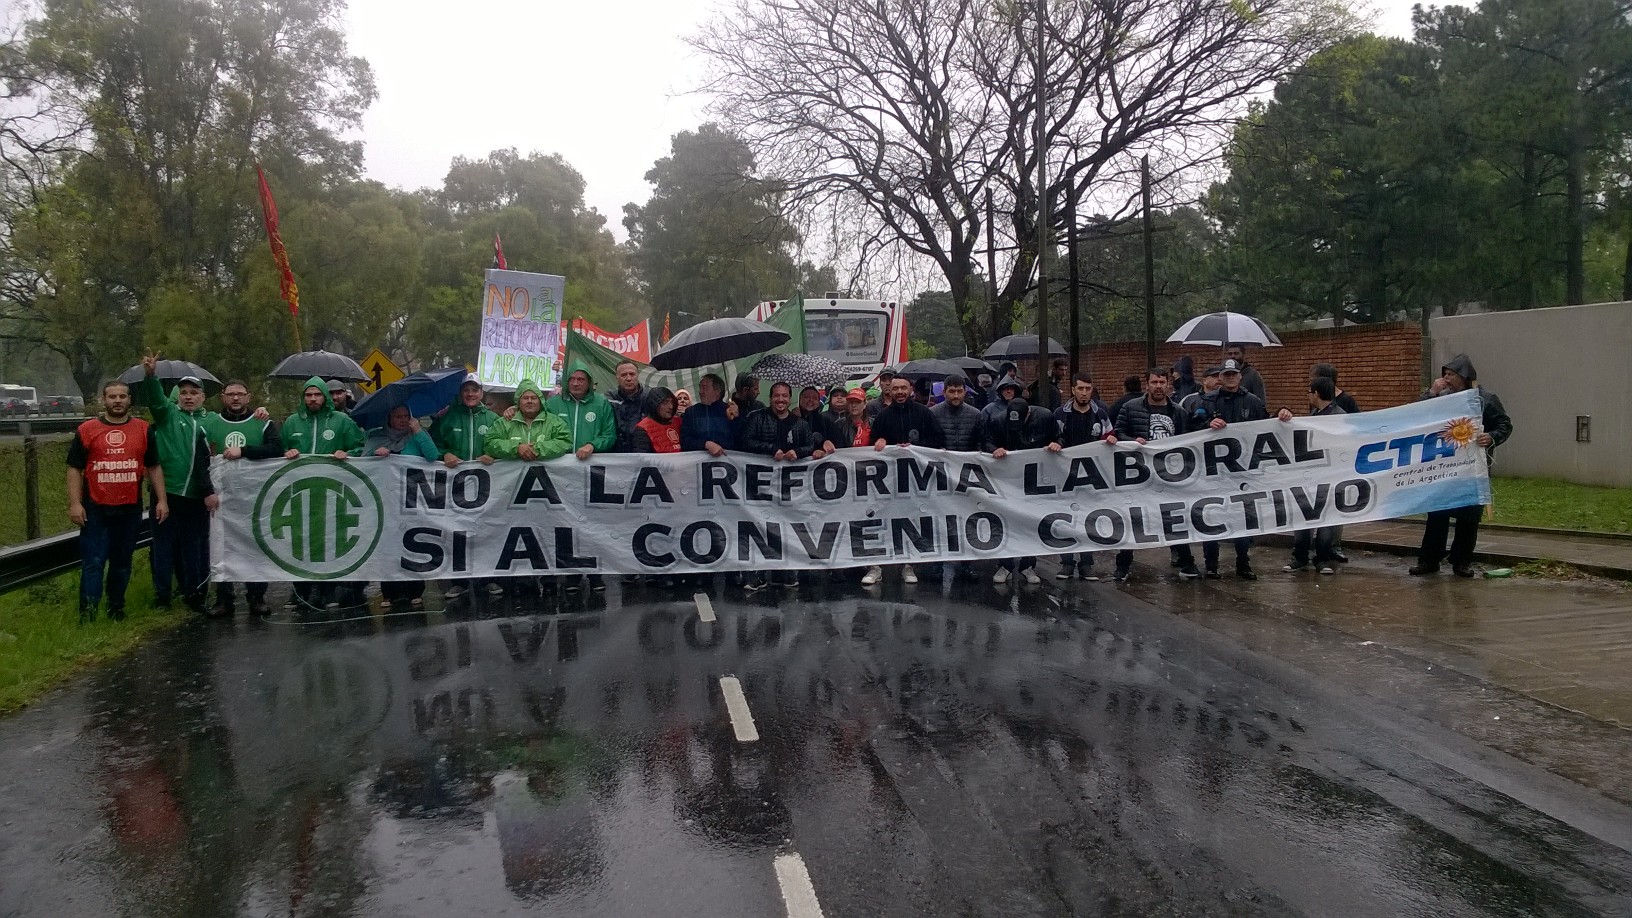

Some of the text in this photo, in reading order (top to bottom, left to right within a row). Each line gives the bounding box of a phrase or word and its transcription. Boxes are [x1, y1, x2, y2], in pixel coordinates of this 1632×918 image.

[486, 284, 530, 319] NO
[482, 318, 559, 355] REFORMA
[480, 352, 556, 388] LABORAL
[405, 429, 1325, 510] NO A LA REFORMA LABORAL
[1355, 430, 1456, 475] CTA
[1426, 464, 1437, 472] de
[97, 471, 138, 483] NARANJA
[1407, 478, 1415, 486] la
[1418, 471, 1458, 484] Argentina
[269, 476, 363, 563] ATE
[400, 526, 468, 573] SI
[495, 526, 598, 570] AL
[1037, 478, 1372, 549] COLECTIVO
